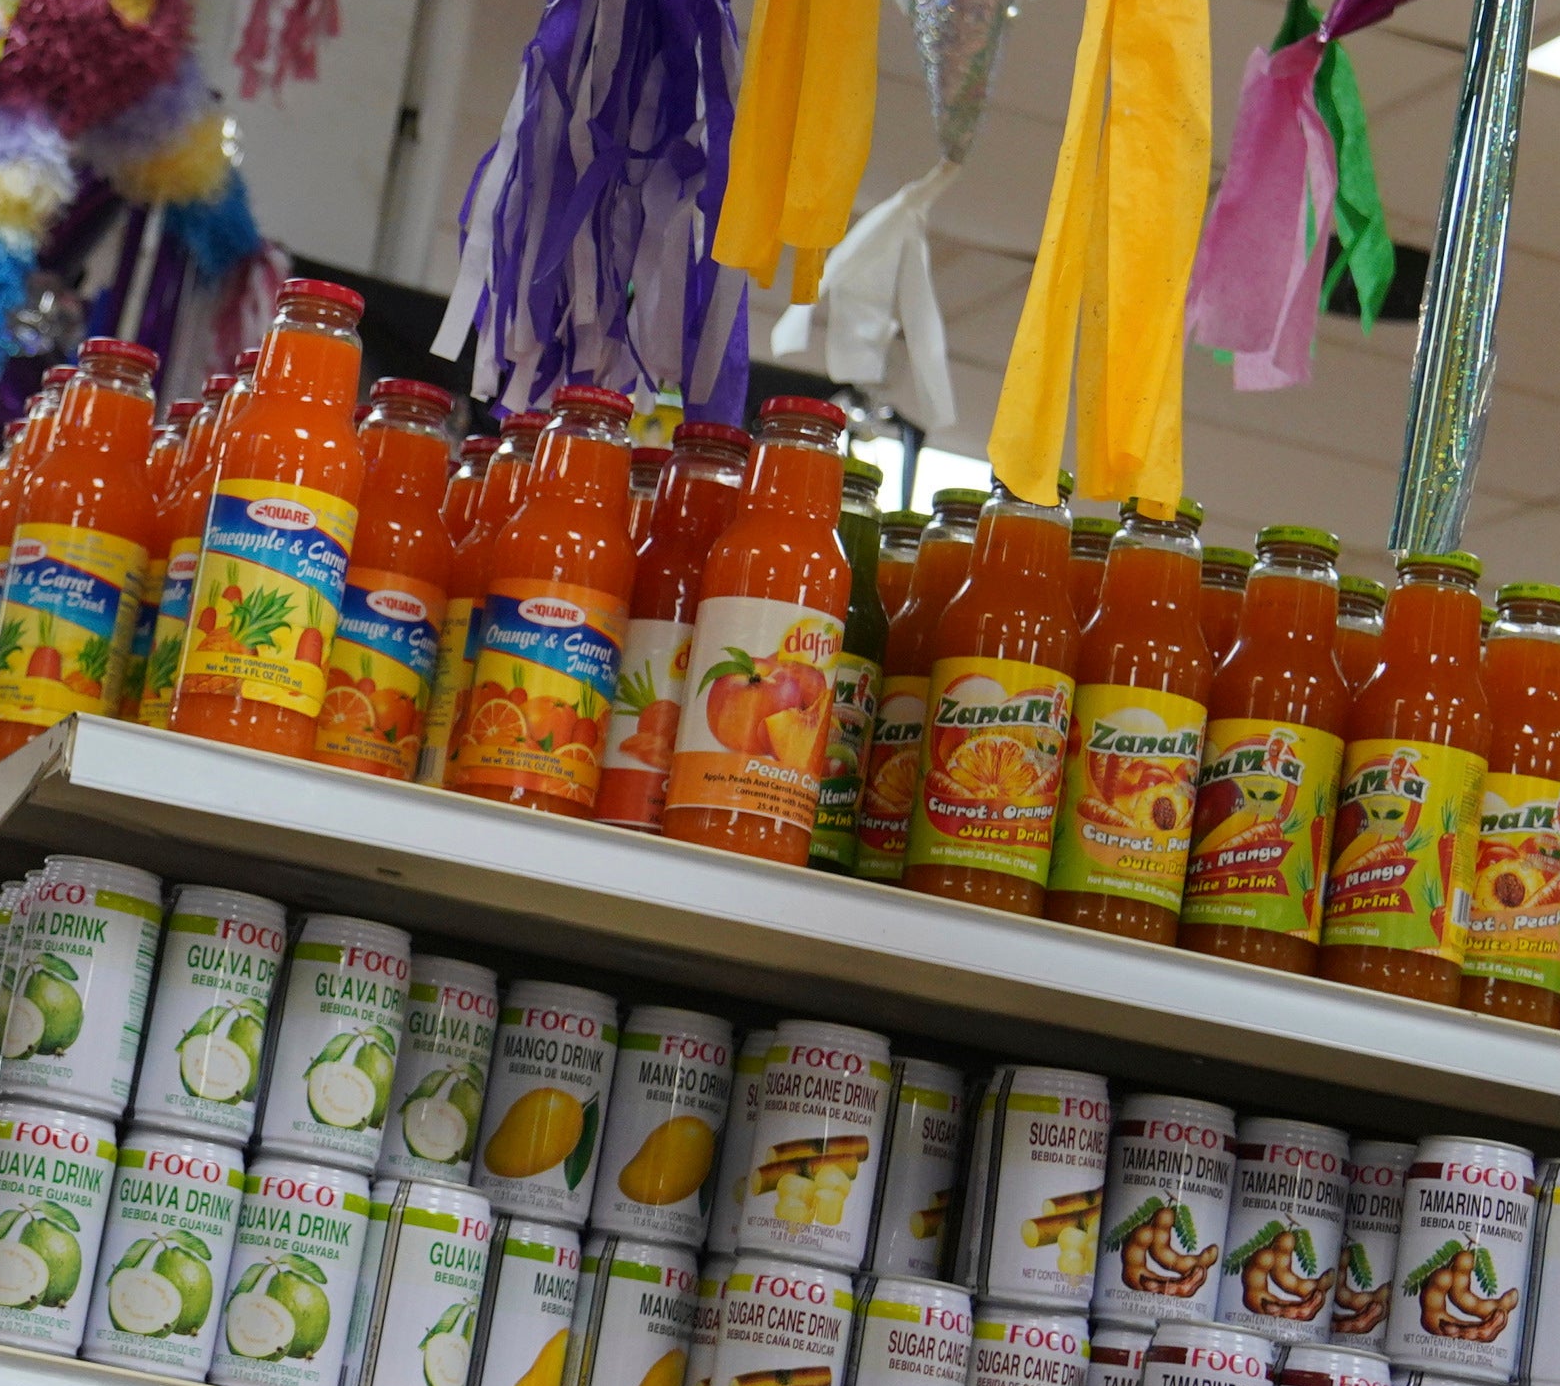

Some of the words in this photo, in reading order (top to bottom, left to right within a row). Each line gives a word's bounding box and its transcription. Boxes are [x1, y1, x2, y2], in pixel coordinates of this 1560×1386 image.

[744, 759, 785, 781] Peach
[928, 796, 988, 819] Carrot
[1004, 804, 1054, 820] Orange
[959, 824, 1009, 840] Juice
[1016, 826, 1049, 844] Drink
[1082, 823, 1155, 851] Carrot
[1119, 855, 1165, 873] Juice
[1217, 844, 1283, 868] Mango
[1227, 874, 1277, 891] Drink
[1344, 863, 1407, 886] Mango
[1351, 892, 1401, 909] Drink
[1514, 937, 1559, 954] Drink
[503, 1035, 559, 1062] MANGO
[16, 1121, 90, 1154] FOCO
[148, 1151, 221, 1183] FOCO
[119, 1176, 180, 1211] GUAVA
[262, 1176, 336, 1208] FOCO
[291, 1240, 341, 1261] GUAYABA
[754, 1273, 827, 1305] FOCO
[887, 1330, 929, 1359] SUGAR
[1020, 1355, 1057, 1383] CANE
[1191, 1347, 1262, 1380] FOCO
